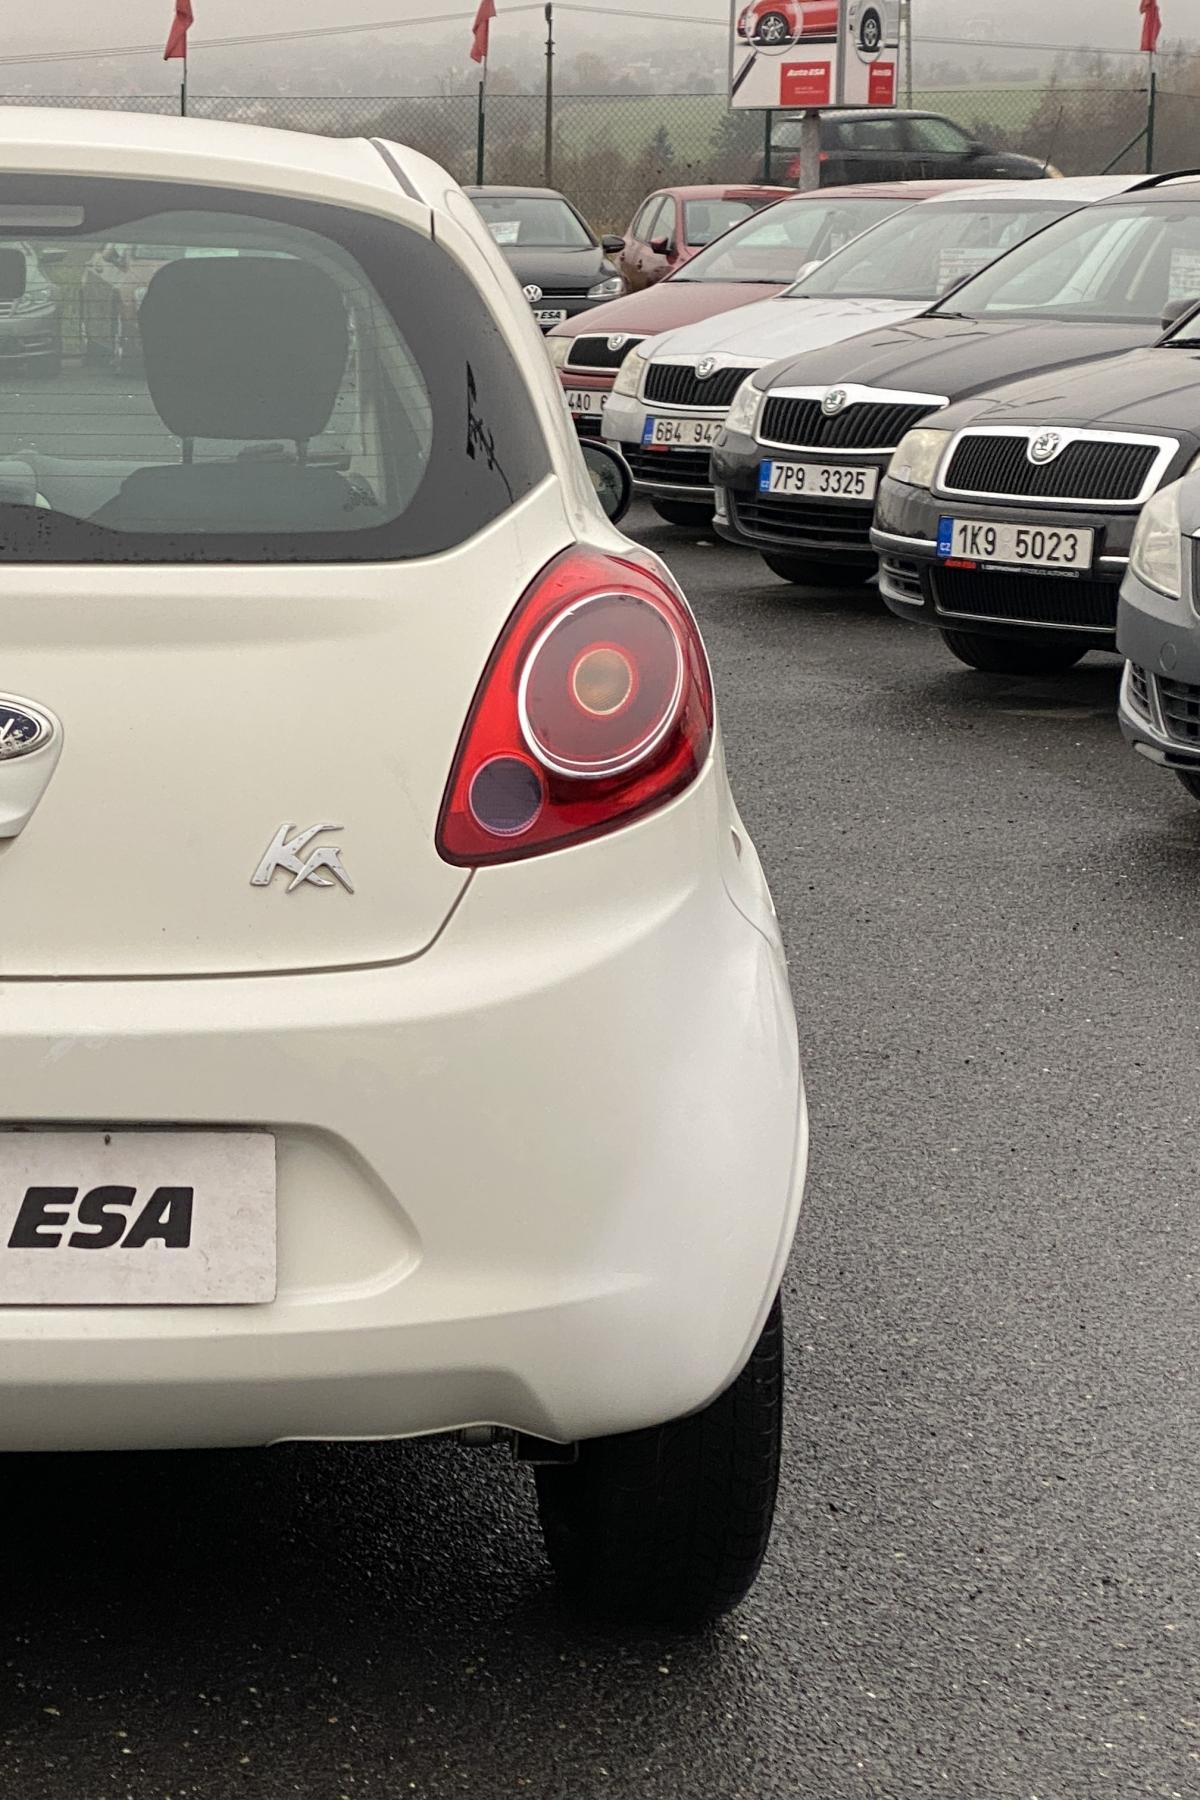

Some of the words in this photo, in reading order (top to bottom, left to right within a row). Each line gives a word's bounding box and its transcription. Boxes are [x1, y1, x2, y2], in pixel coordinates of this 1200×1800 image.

[773, 465, 805, 491] 7P9
[819, 469, 867, 495] 3325
[958, 524, 997, 556] 1K9
[1015, 529, 1078, 562] 5023
[6, 1185, 195, 1249] ESA
